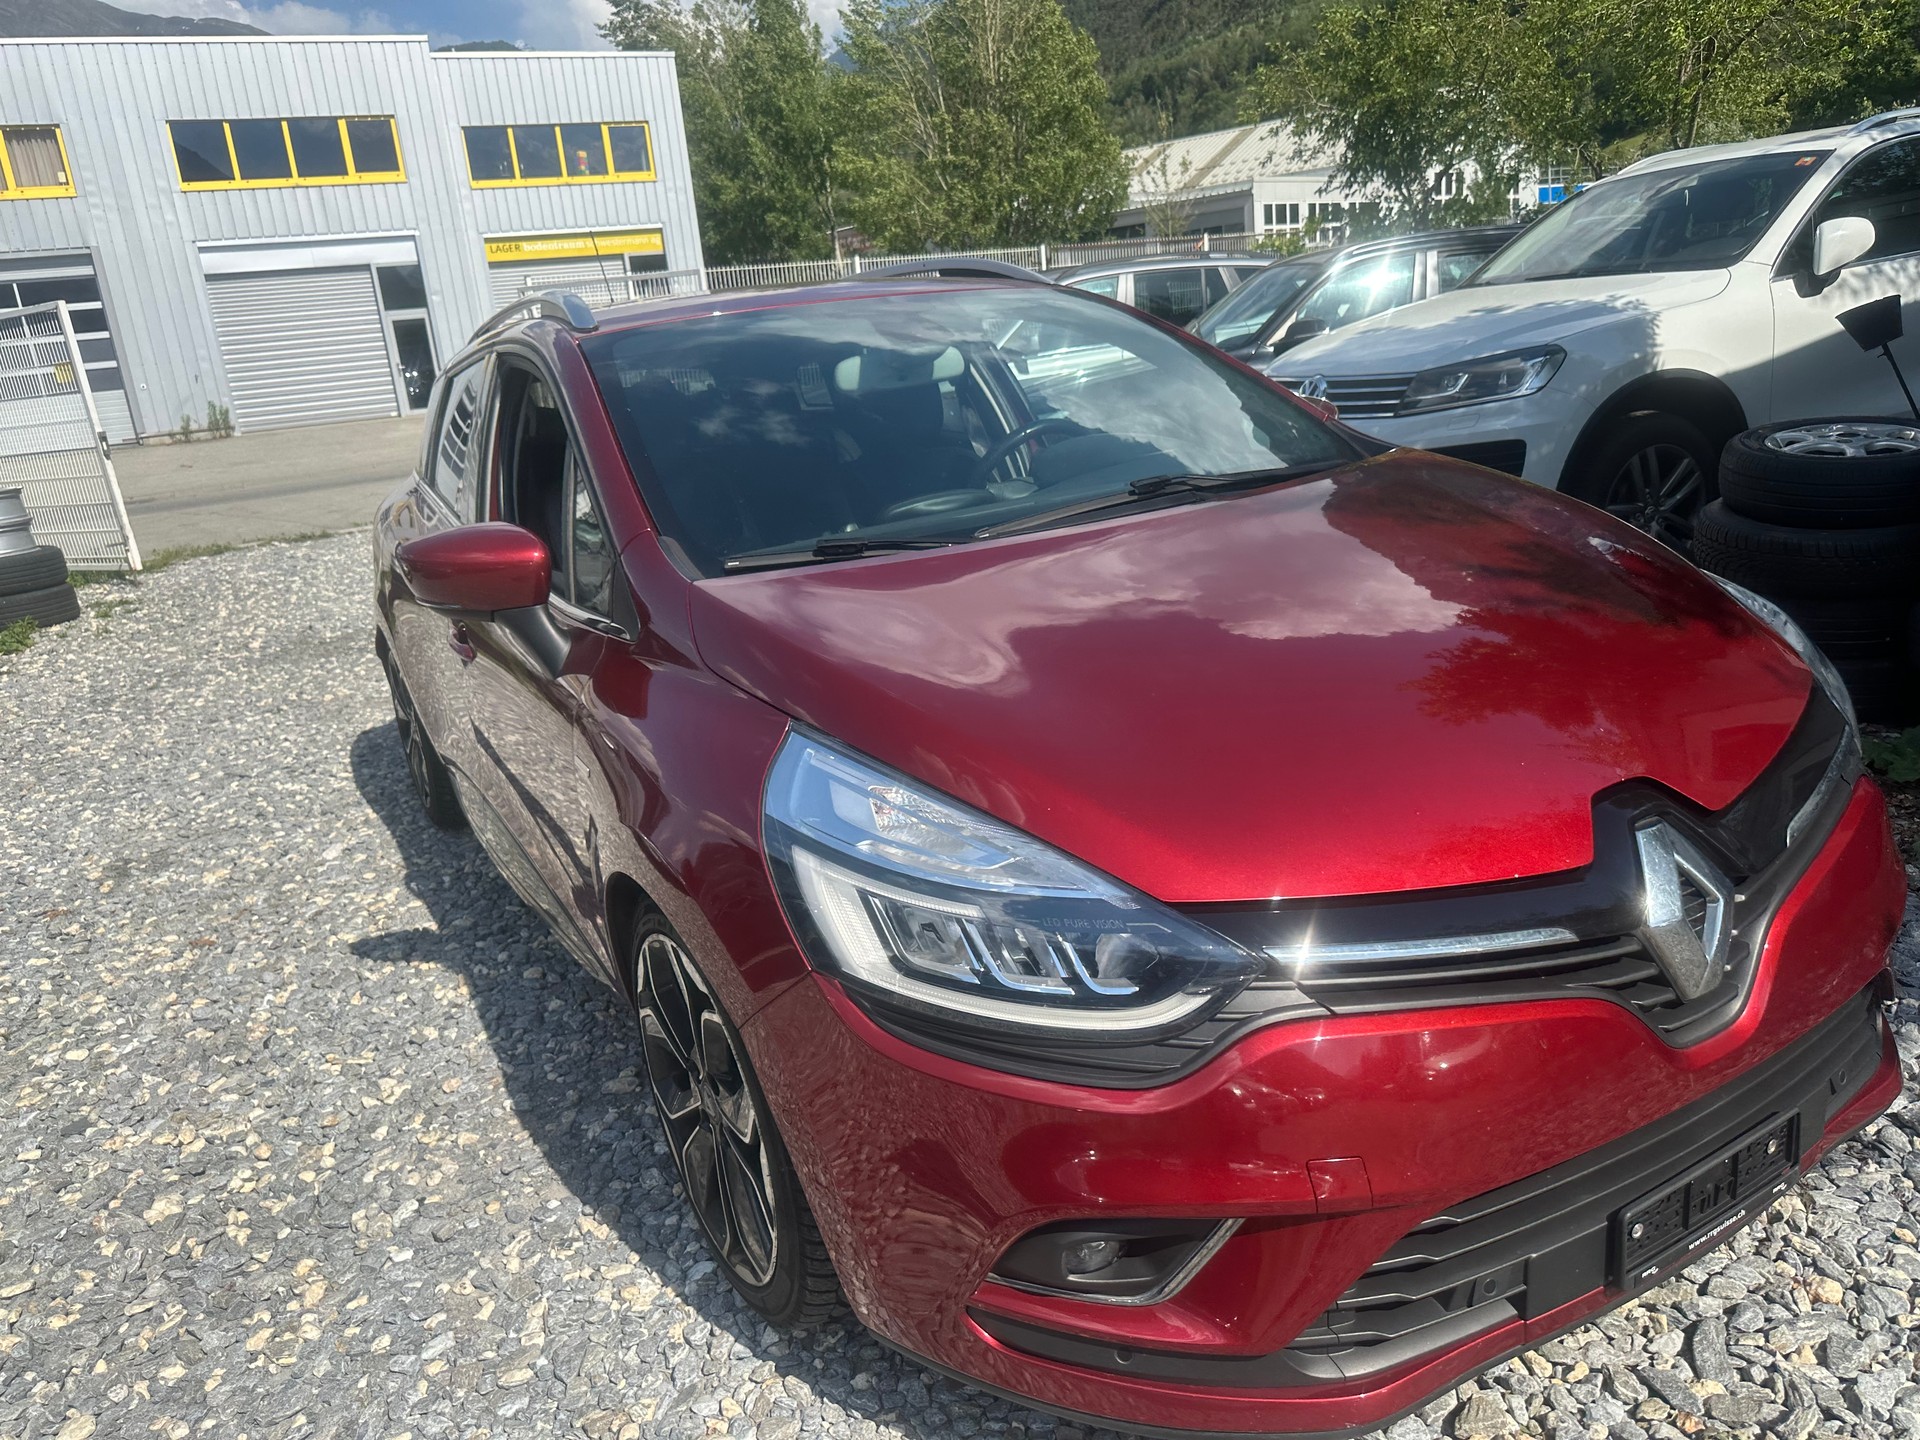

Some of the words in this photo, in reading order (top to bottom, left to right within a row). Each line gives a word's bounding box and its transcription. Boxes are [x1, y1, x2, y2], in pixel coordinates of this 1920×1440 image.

[490, 243, 521, 254] LAGER
[523, 240, 585, 252] bodentraum
[1043, 918, 1060, 927] LED
[1064, 919, 1091, 928] PURE
[1093, 919, 1124, 929] VISION
[1689, 1210, 1745, 1250] www.rrgsuisse.ch
